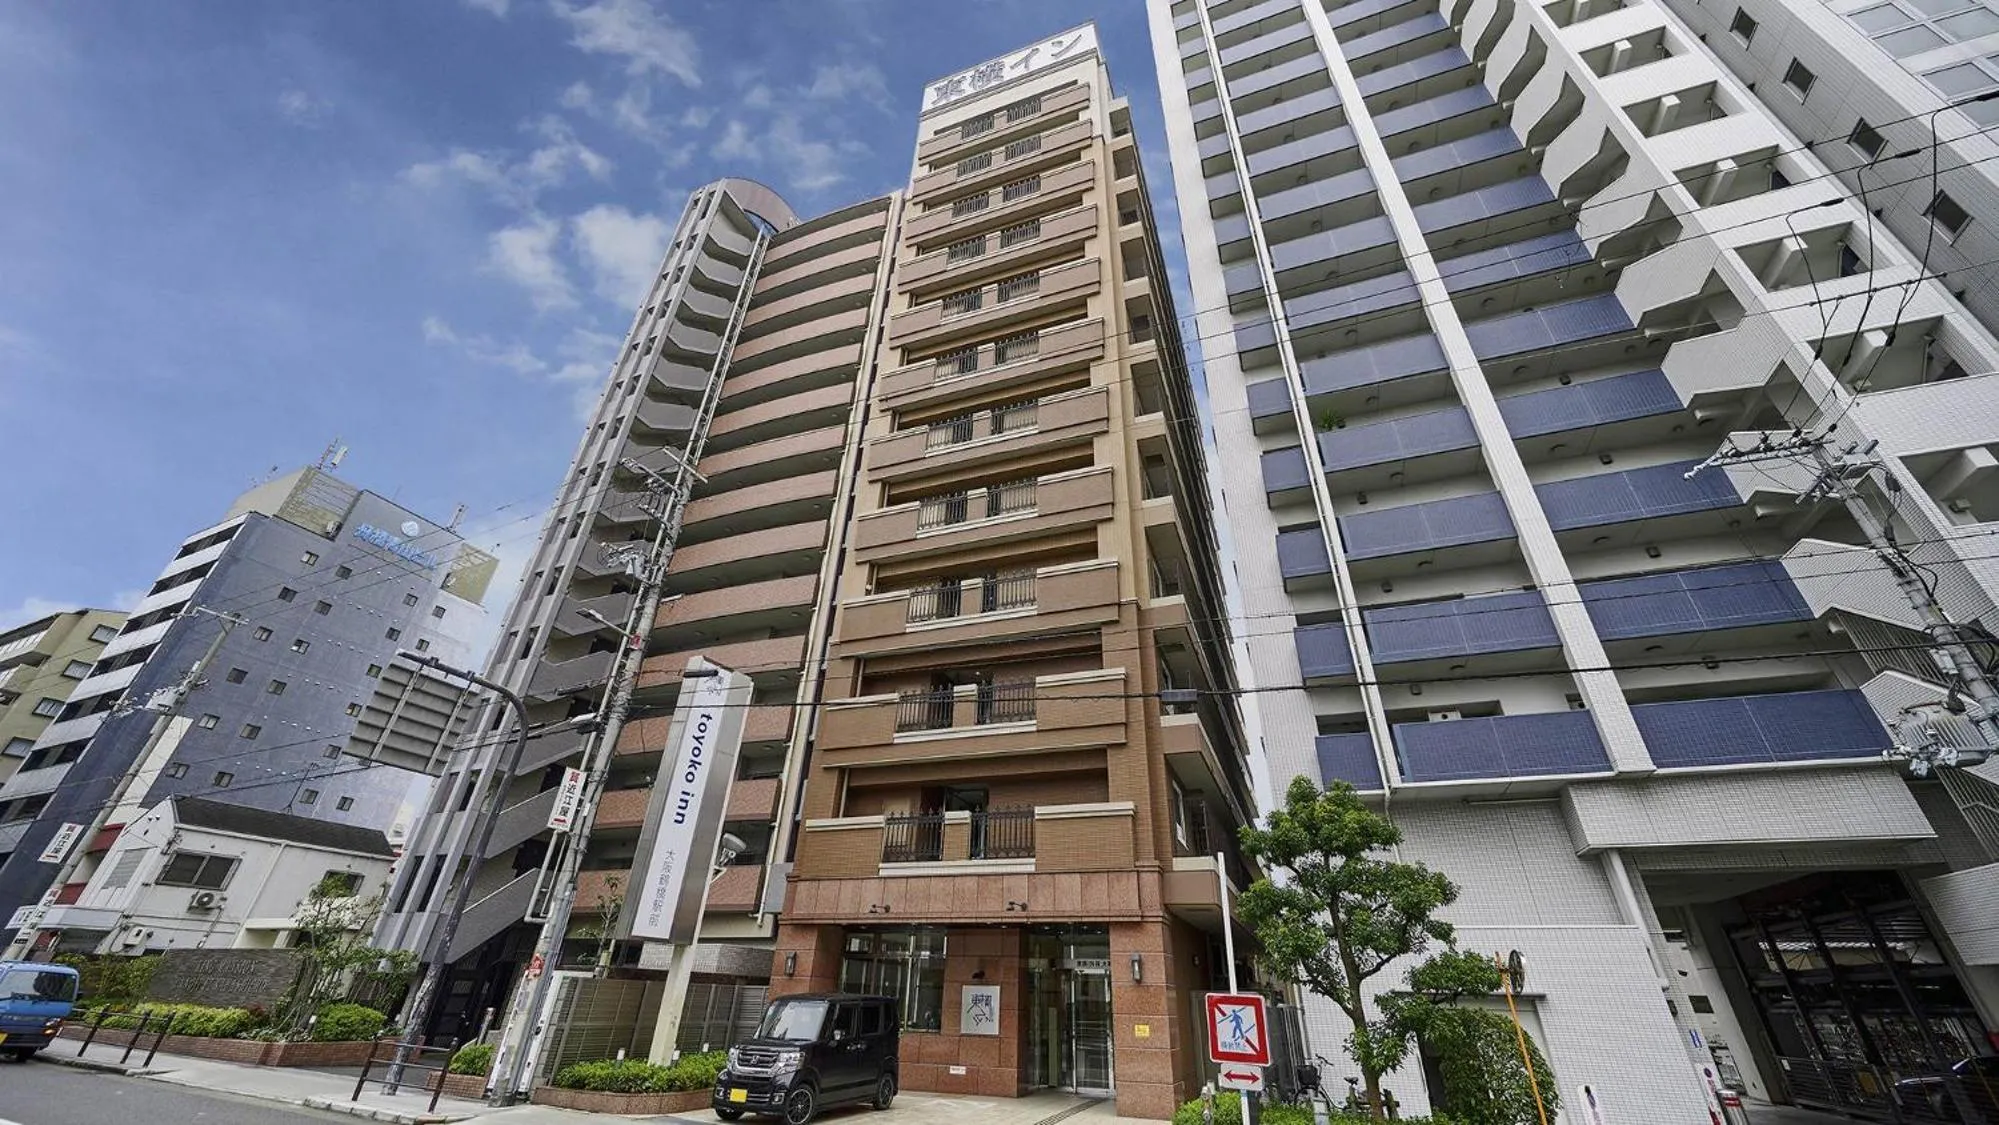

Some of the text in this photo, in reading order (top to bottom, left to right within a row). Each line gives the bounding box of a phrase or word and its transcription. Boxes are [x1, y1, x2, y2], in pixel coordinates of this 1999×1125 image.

[932, 34, 1082, 105] 東横イン
[673, 713, 713, 825] toyoko inn
